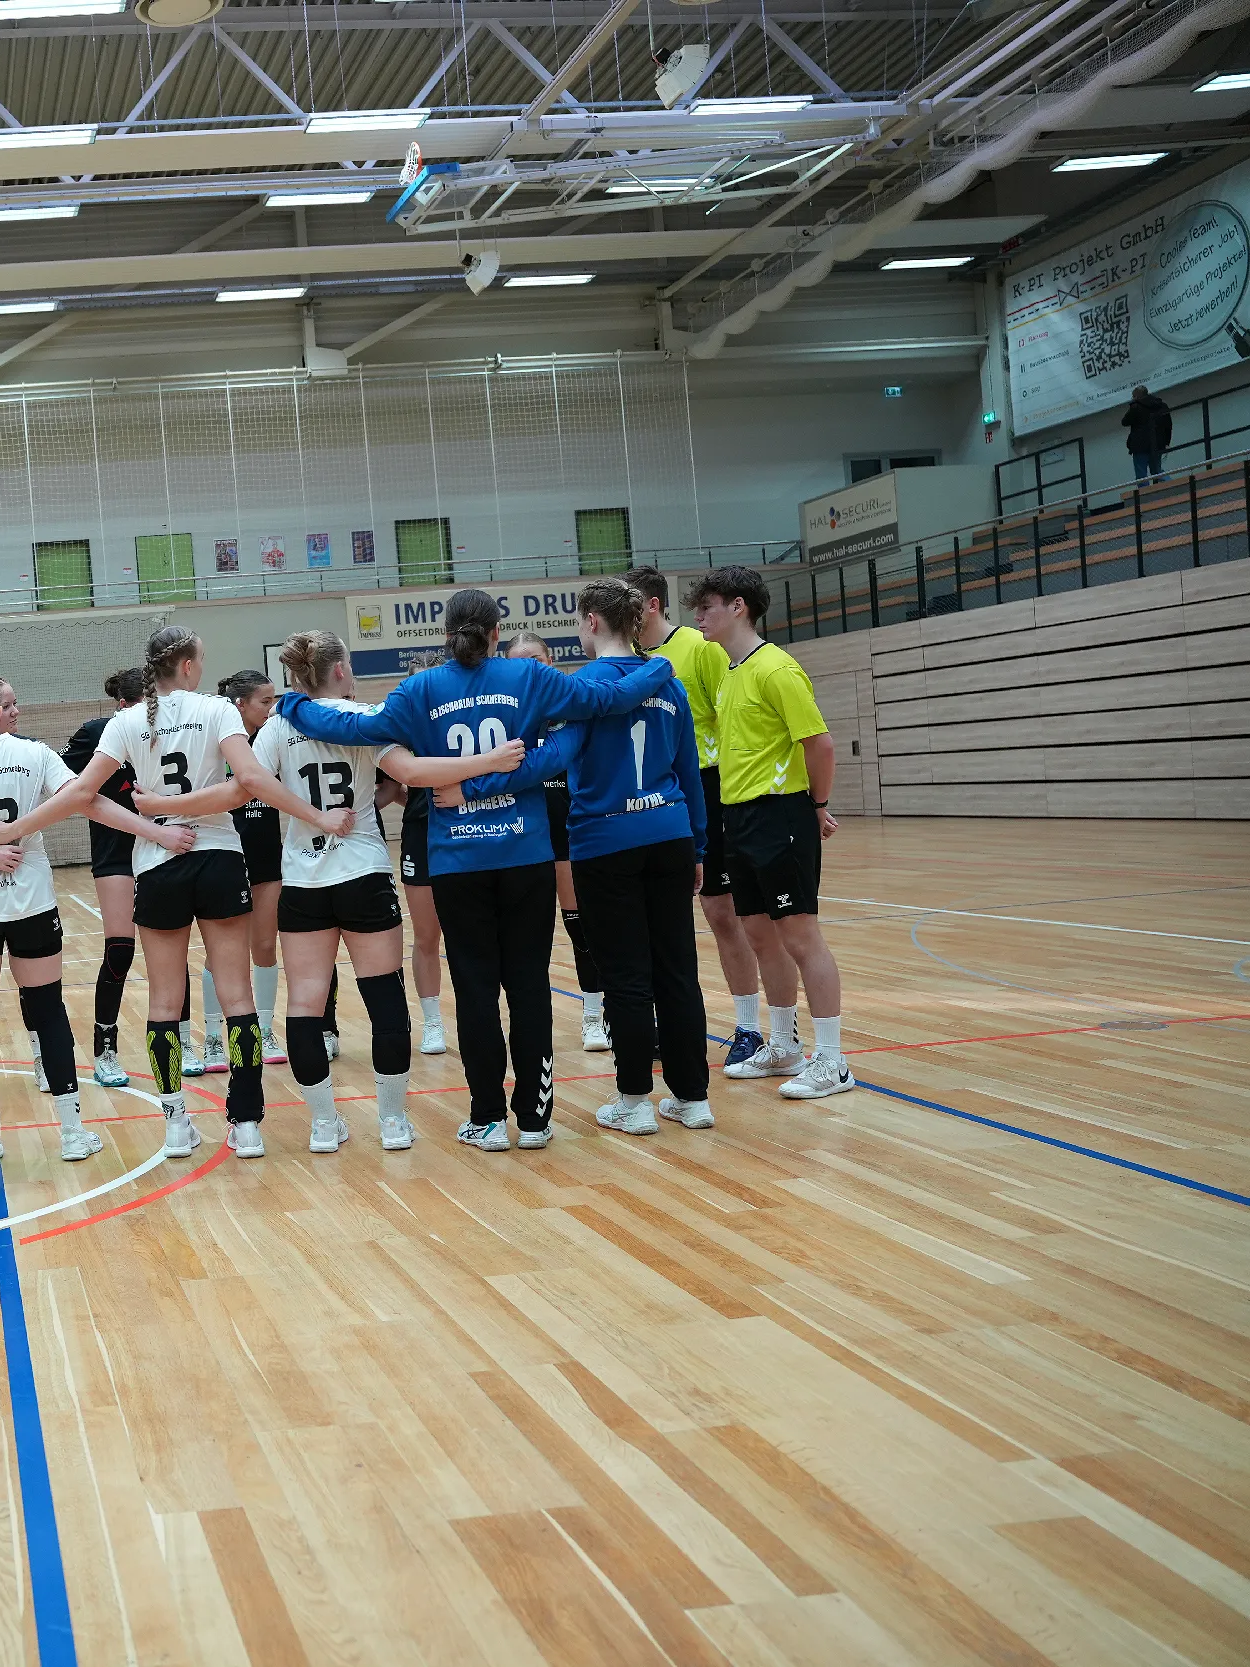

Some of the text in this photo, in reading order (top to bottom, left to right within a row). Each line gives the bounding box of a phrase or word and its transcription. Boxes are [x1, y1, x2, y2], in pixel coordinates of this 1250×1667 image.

[1159, 214, 1219, 268] Cooles Team!
[1218, 224, 1239, 248] Job!
[1012, 216, 1166, 298] K-PI Projekt GmbH
[1111, 252, 1148, 282] K-PI
[1150, 244, 1247, 319] Einzigartige Projekte!
[1168, 275, 1238, 334] Jetzt bewerben!
[810, 515, 829, 529] HAL
[842, 498, 880, 519] SECURI
[812, 533, 894, 563] www.hal-securi.com
[396, 619, 579, 638] OFFSETDRU DRUCK BESCHRIF
[630, 720, 646, 790] 1
[160, 752, 192, 796] 3
[298, 762, 354, 811] 13
[245, 810, 262, 818] Halle
[626, 792, 665, 811] KOTHE
[450, 822, 511, 835] PROKLIMA
